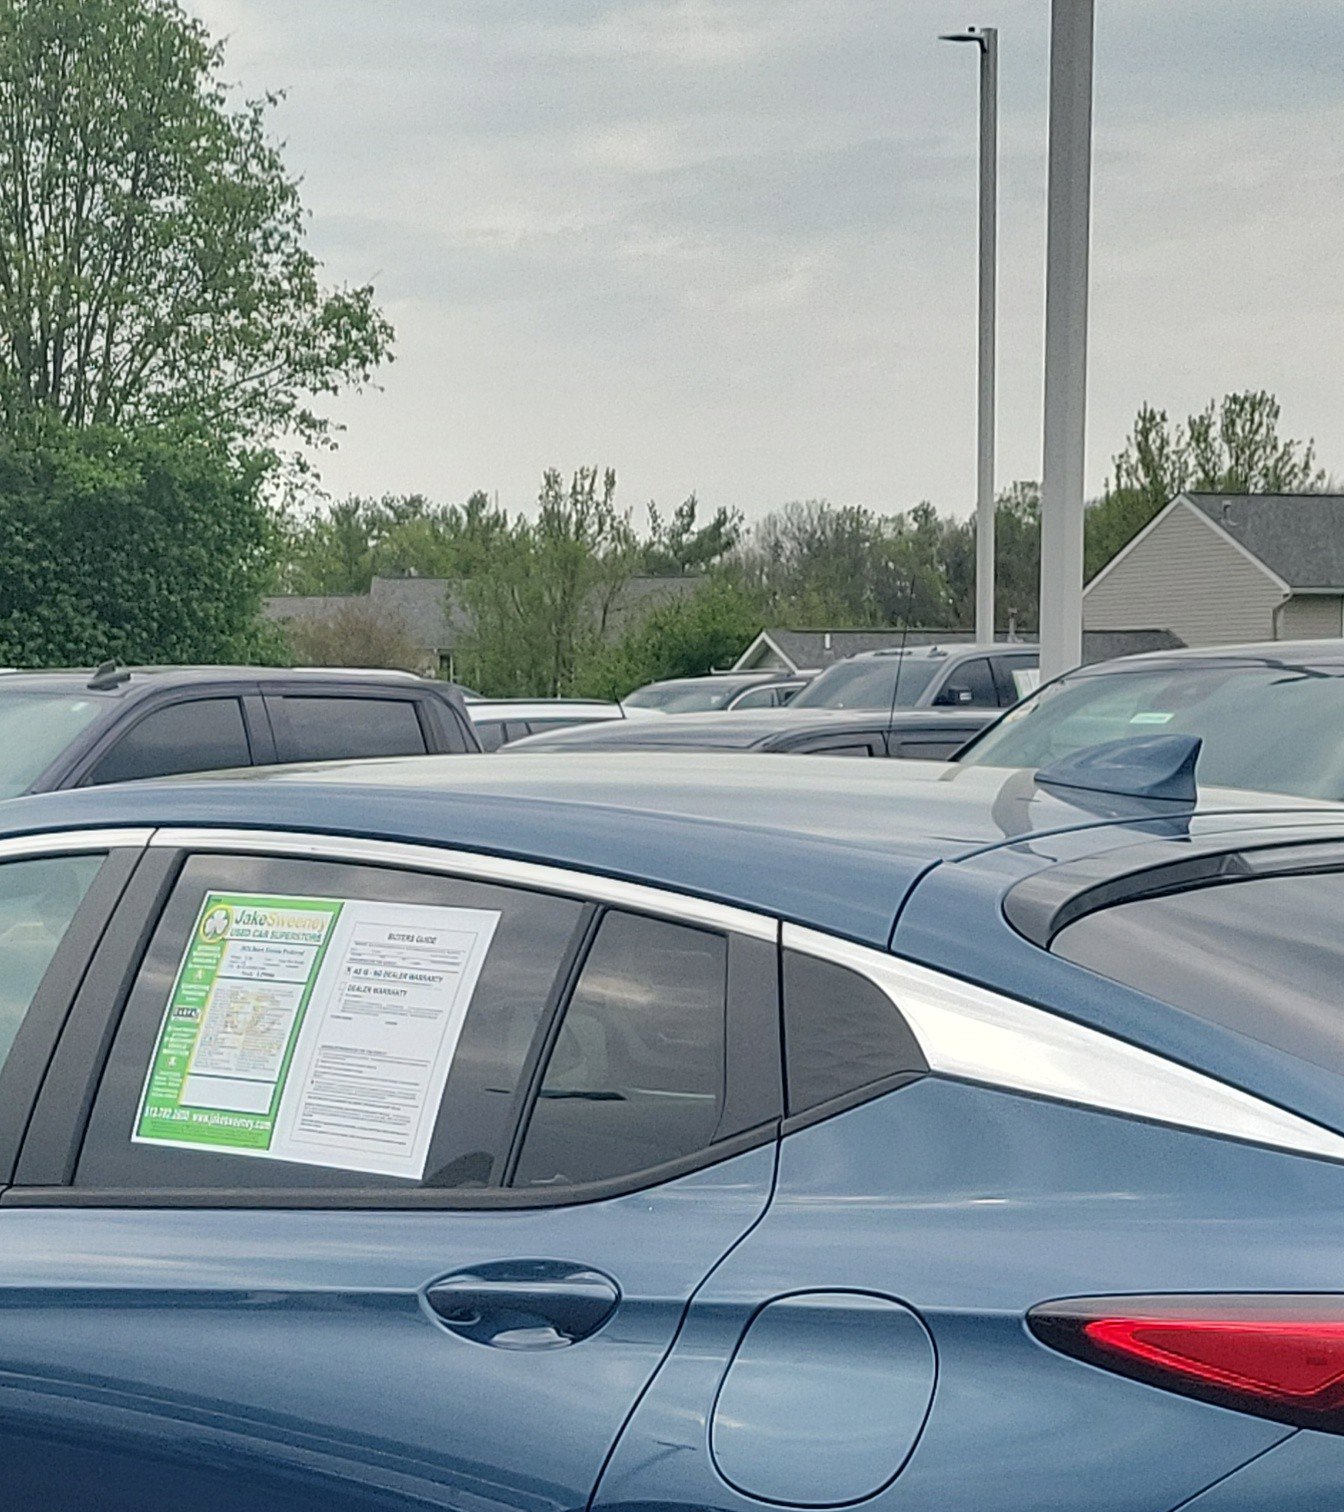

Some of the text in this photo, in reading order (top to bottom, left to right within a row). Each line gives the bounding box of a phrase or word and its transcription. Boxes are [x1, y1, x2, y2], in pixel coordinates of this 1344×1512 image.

[234, 909, 326, 932] JakeSweeney
[252, 929, 269, 939] CAR
[347, 984, 371, 993] DEALER
